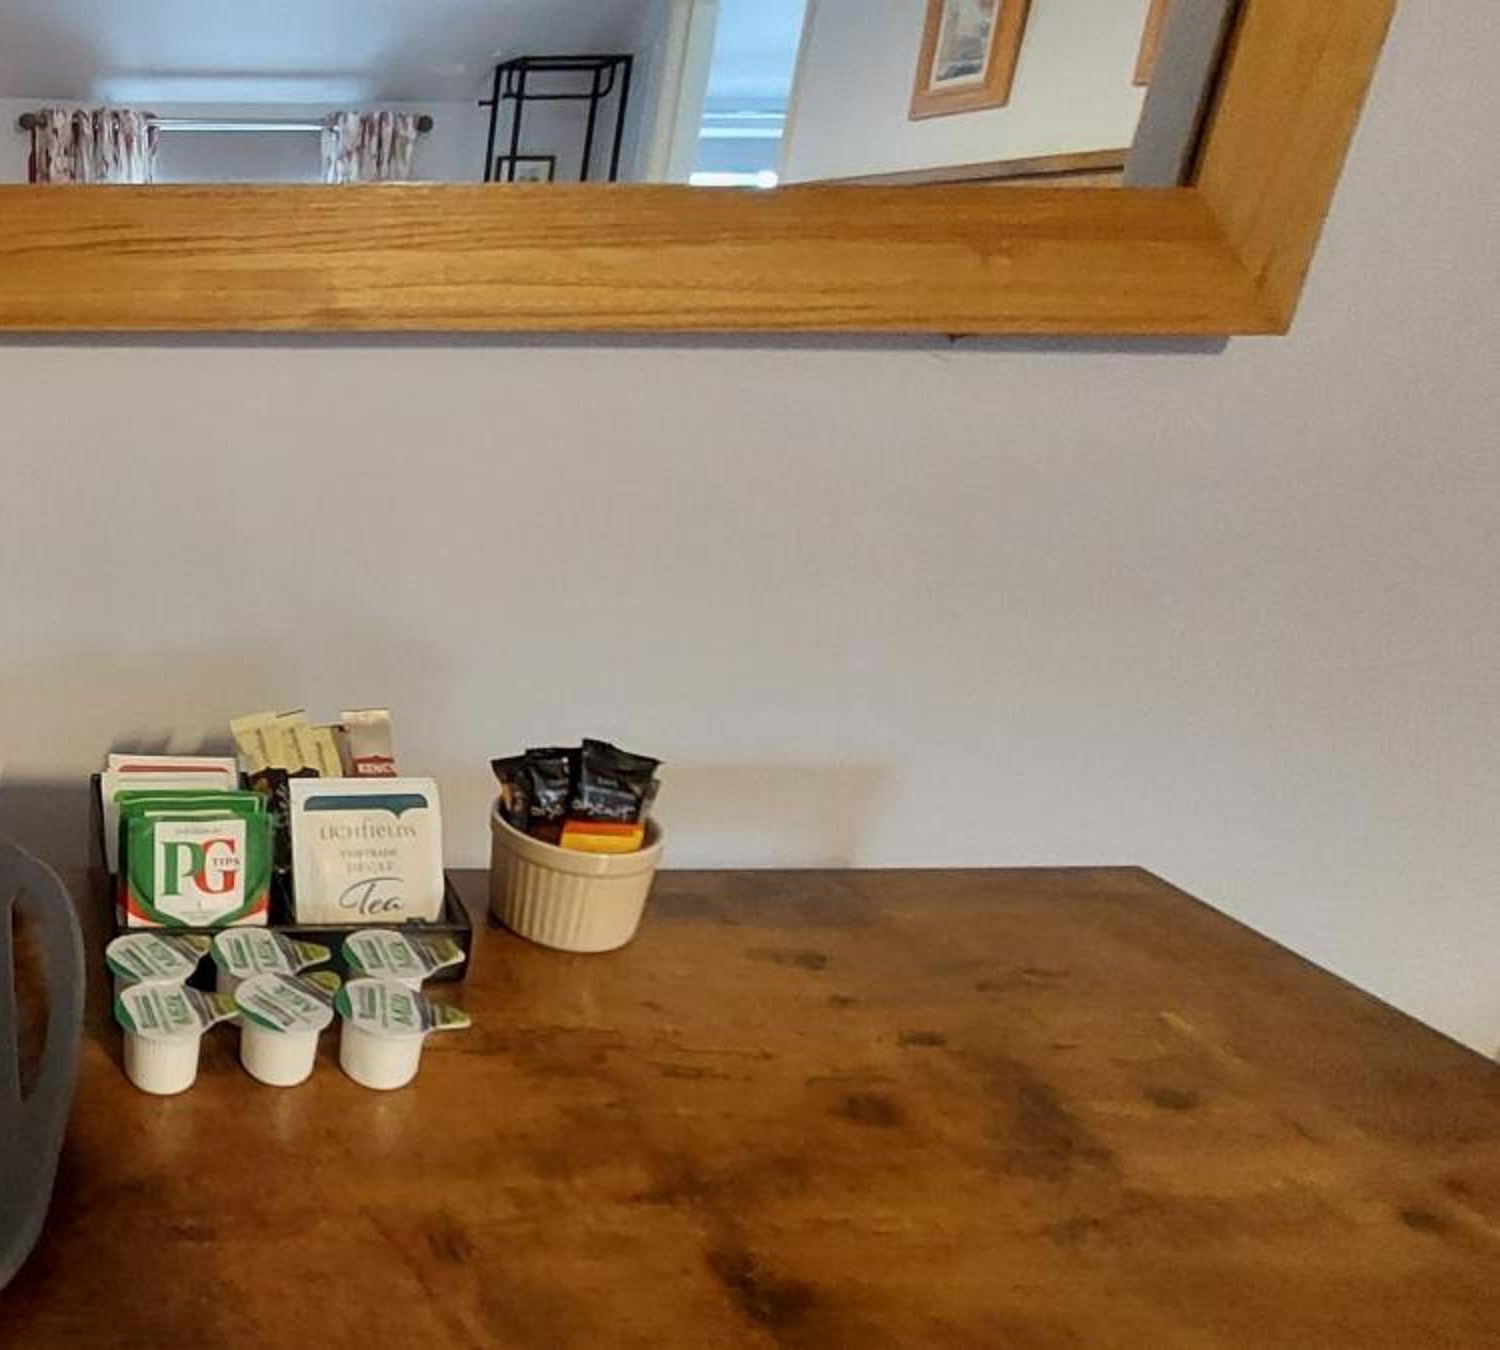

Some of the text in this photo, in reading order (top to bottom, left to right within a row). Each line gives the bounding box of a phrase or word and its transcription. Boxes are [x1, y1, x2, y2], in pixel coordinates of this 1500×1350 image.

[161, 839, 235, 896] PG
[212, 857, 240, 866] TIPS
[339, 877, 406, 915] Tea
